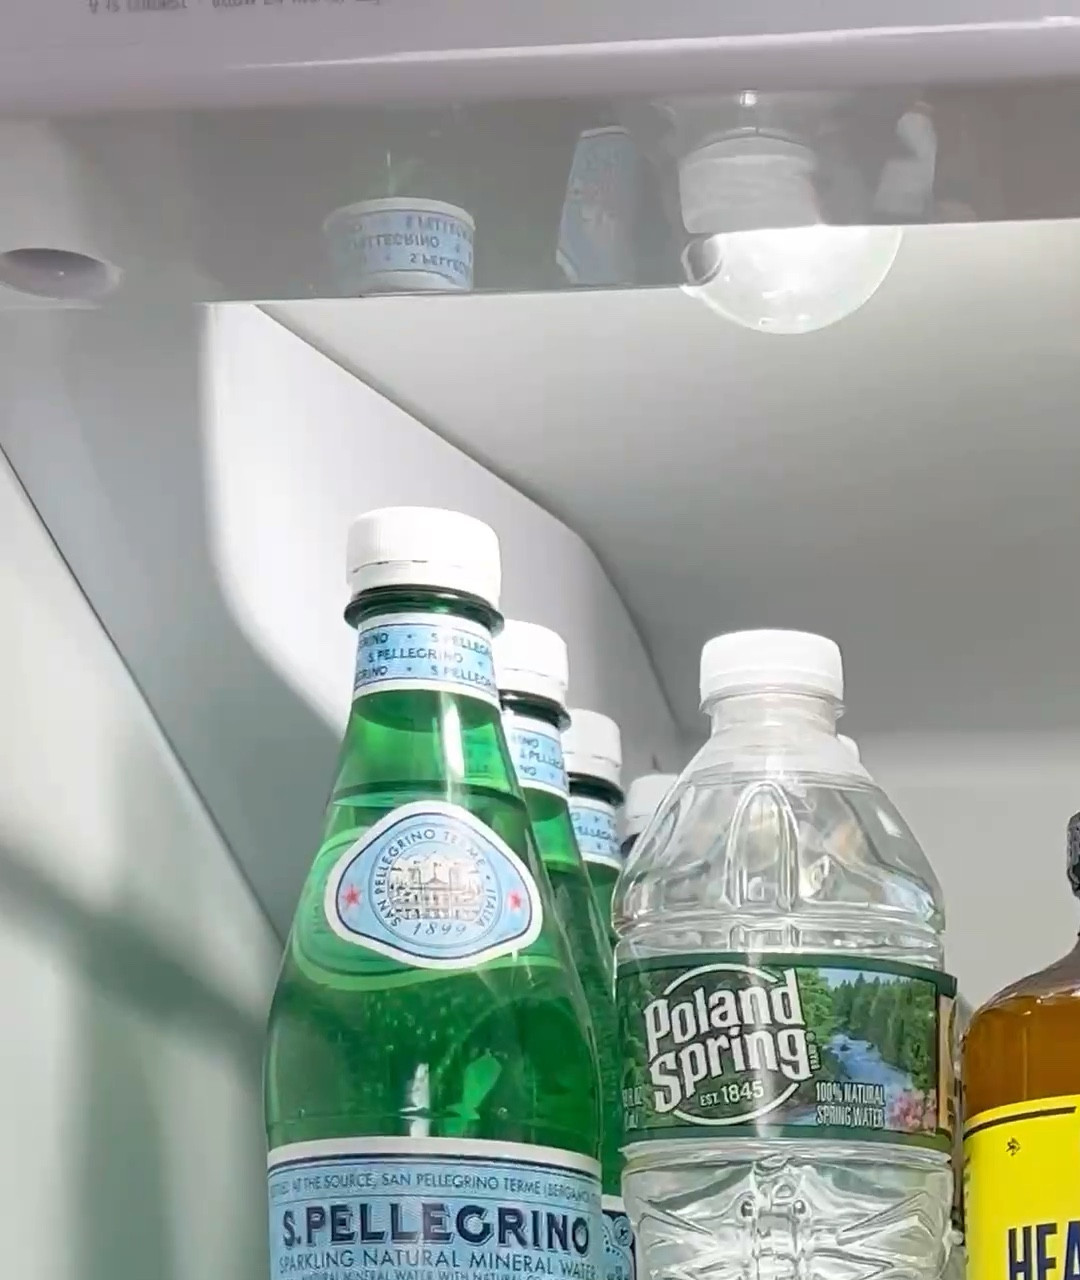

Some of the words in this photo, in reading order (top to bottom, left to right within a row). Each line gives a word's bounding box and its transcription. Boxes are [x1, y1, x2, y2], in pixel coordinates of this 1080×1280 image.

[375, 828, 436, 896] PELLEGRINO
[443, 830, 486, 867] TEME
[412, 921, 467, 937] 1899
[644, 968, 806, 1064] Poland
[649, 1025, 814, 1114] Spring
[721, 1079, 764, 1104] 1845
[816, 1105, 851, 1126] SPRING
[852, 1106, 884, 1129] WATER
[382, 1172, 412, 1188] SAN
[416, 1173, 499, 1191] PELLEGRINO
[503, 1176, 541, 1196] TERME
[282, 1202, 590, 1257] S.PELLEGRINO
[279, 1249, 354, 1274] SPARKLING
[362, 1248, 460, 1269] NATURAL
[469, 1252, 555, 1275] MINERAL
[558, 1258, 596, 1280] WATER
